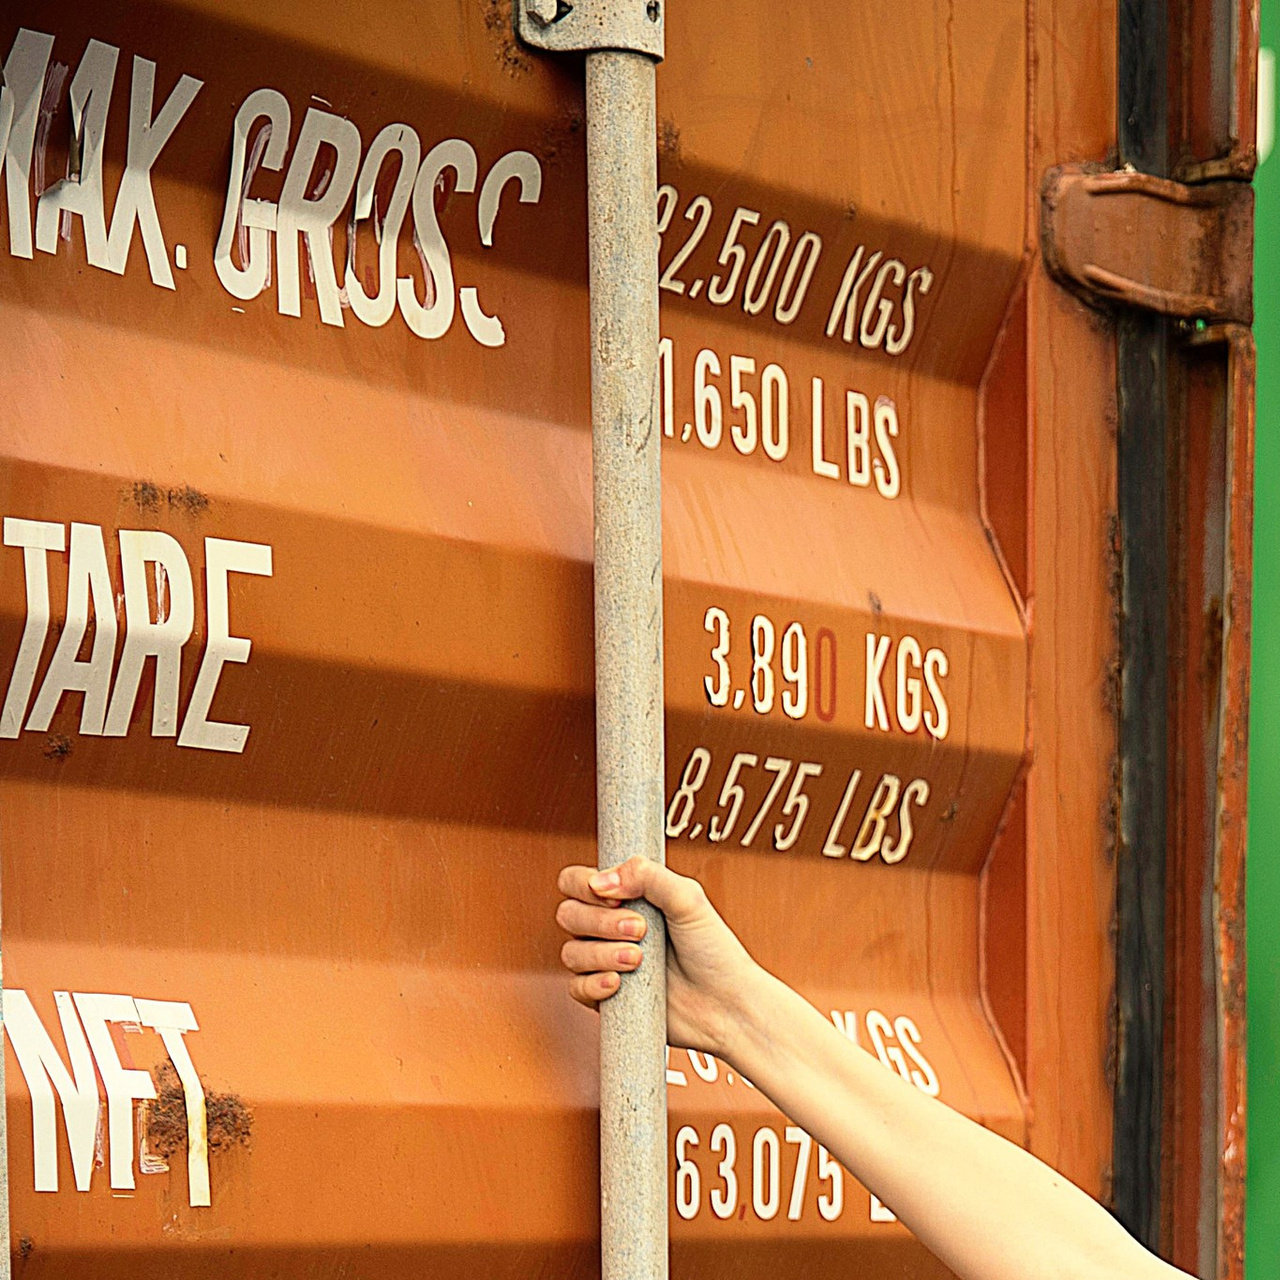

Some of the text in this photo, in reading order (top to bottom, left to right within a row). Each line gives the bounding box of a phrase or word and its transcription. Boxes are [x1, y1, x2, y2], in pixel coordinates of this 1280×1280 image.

[826, 245, 934, 355] KGS
[811, 376, 901, 499] LBS
[0, 517, 273, 753] TARE
[864, 632, 949, 741] KGS
[665, 746, 930, 865] 8,575 LBS
